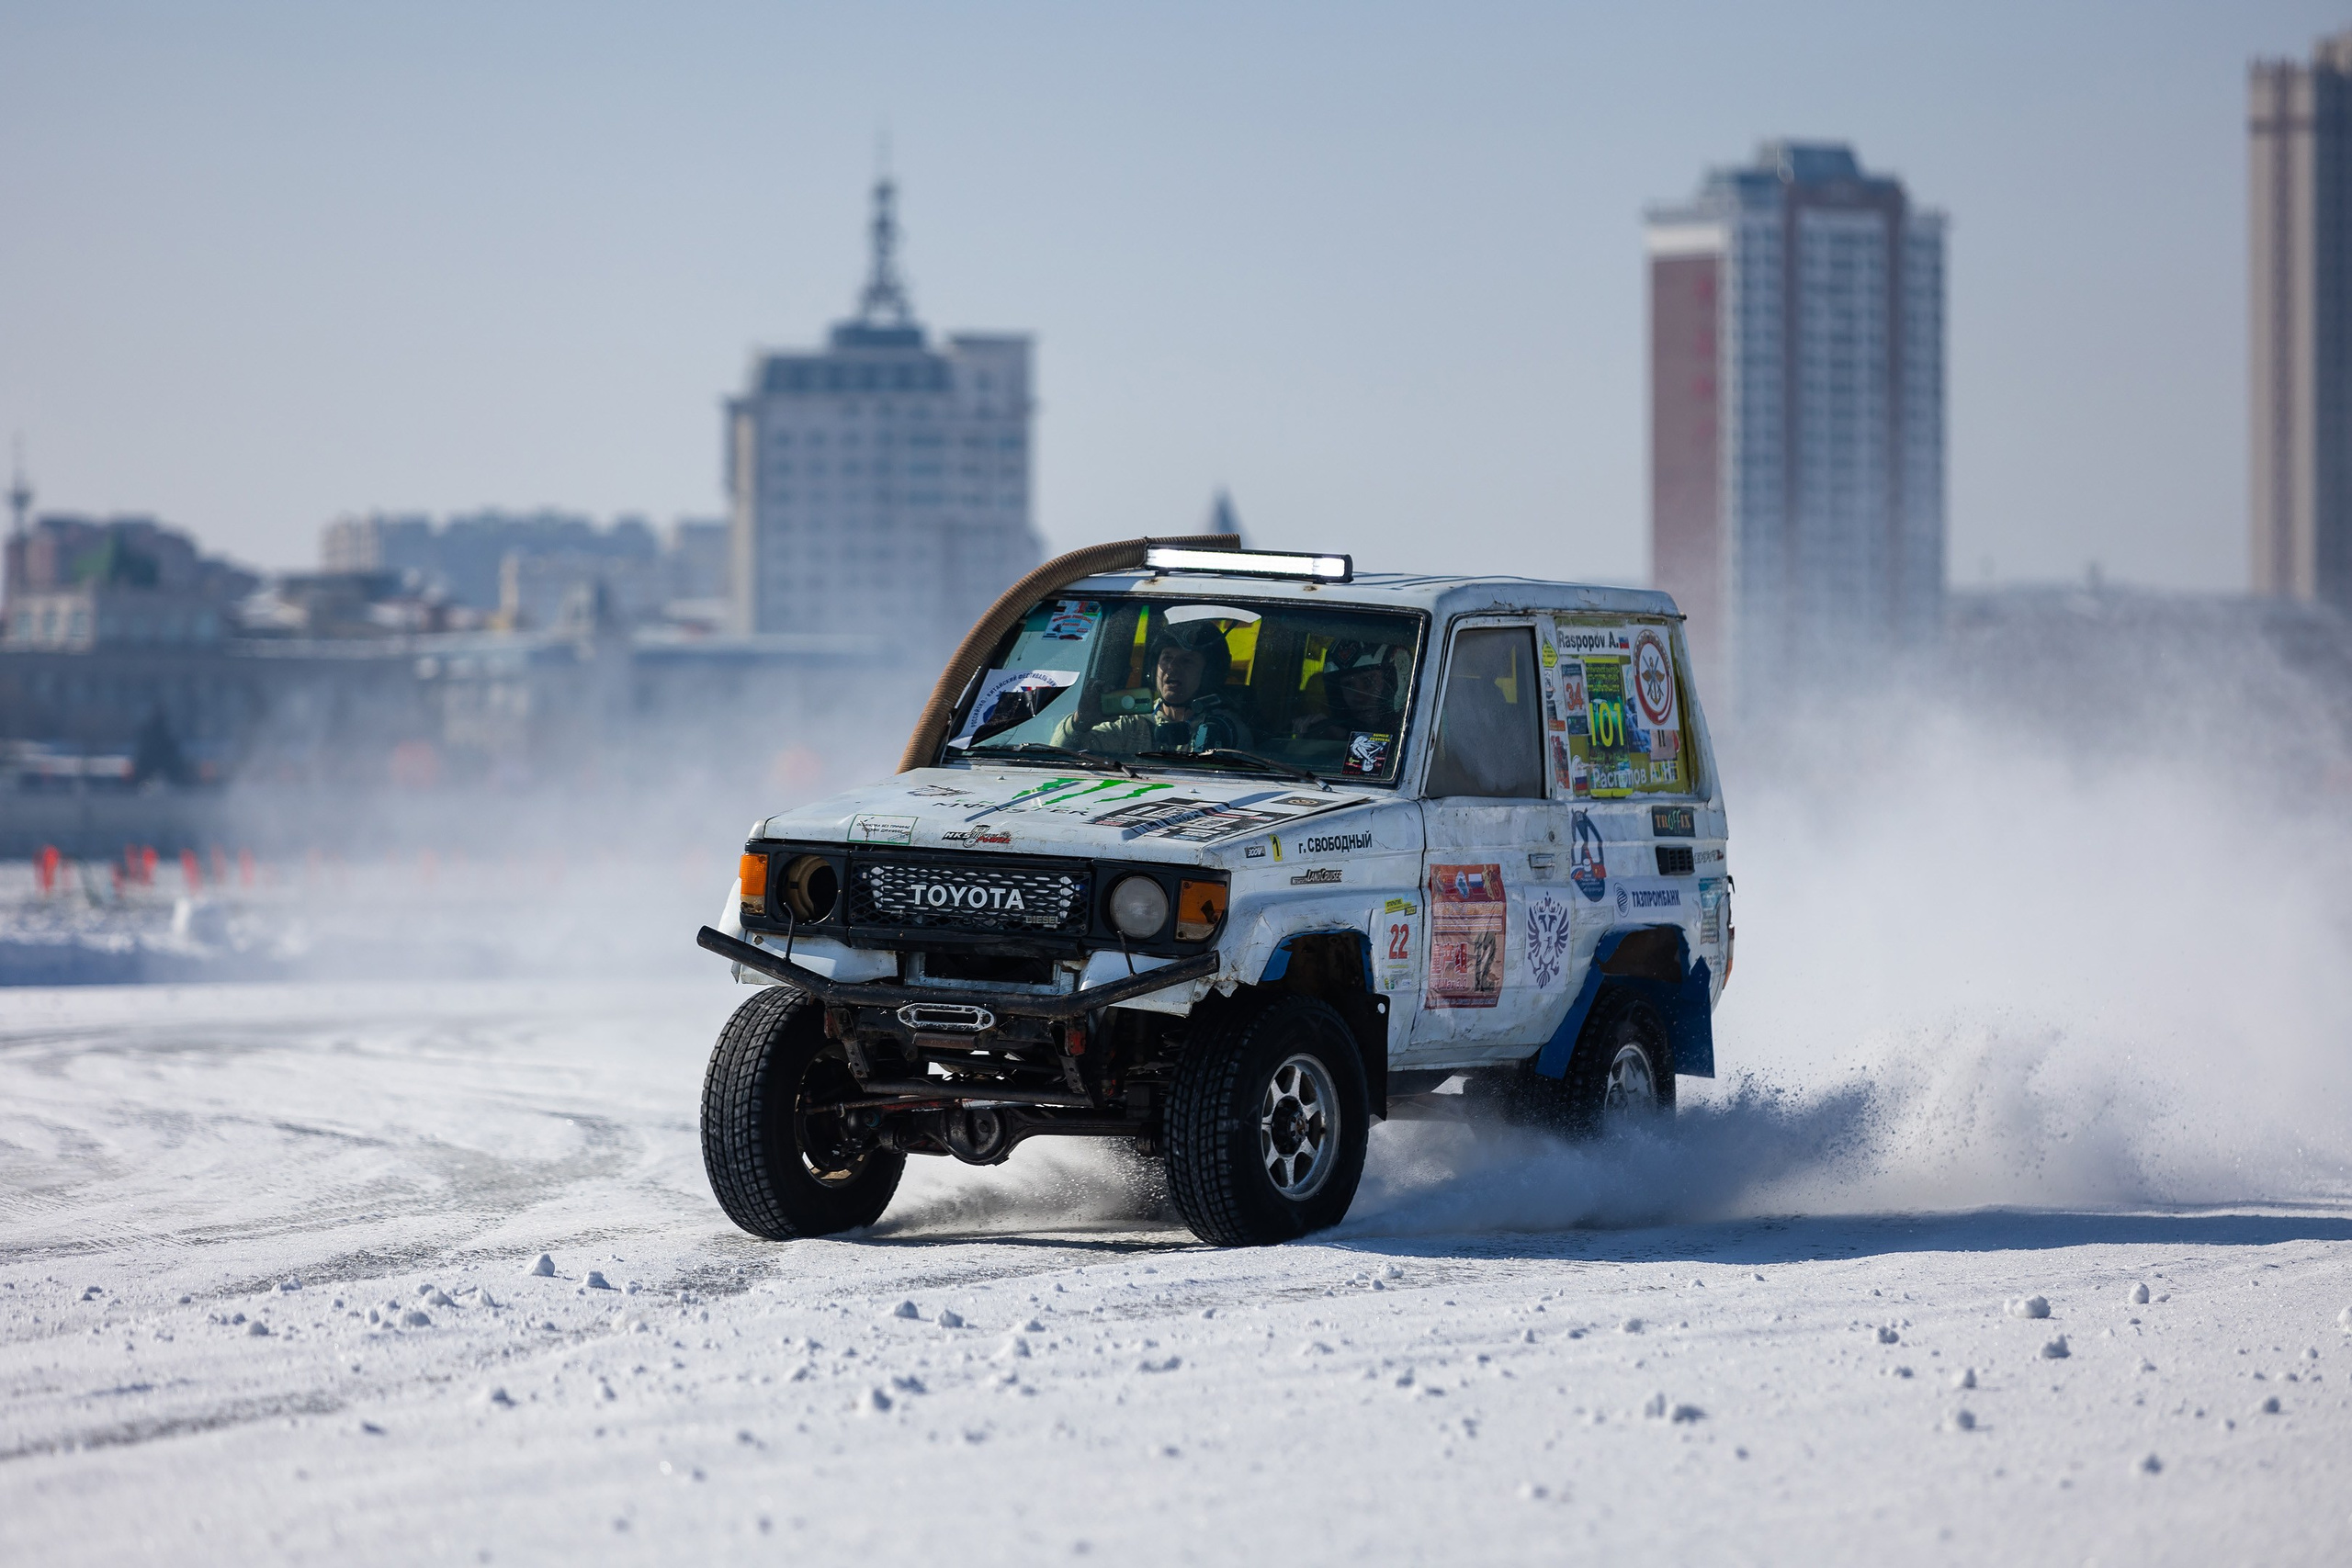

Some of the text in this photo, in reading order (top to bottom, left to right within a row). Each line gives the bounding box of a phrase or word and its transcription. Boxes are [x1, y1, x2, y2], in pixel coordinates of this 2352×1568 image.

[1558, 630, 1619, 651] Raspopov A.
[1566, 682, 1583, 710] 34
[1589, 703, 1623, 747] 101
[1592, 768, 1647, 789] Распопов
[1272, 837, 1280, 857] 1
[1298, 830, 1373, 854] г. СВОБОДНЫЙ
[910, 885, 1025, 910] TOYOTA
[1632, 889, 1681, 908] ГАЗПРОМБАНК
[1025, 915, 1060, 924] DIESEL
[1388, 923, 1409, 959] 22
